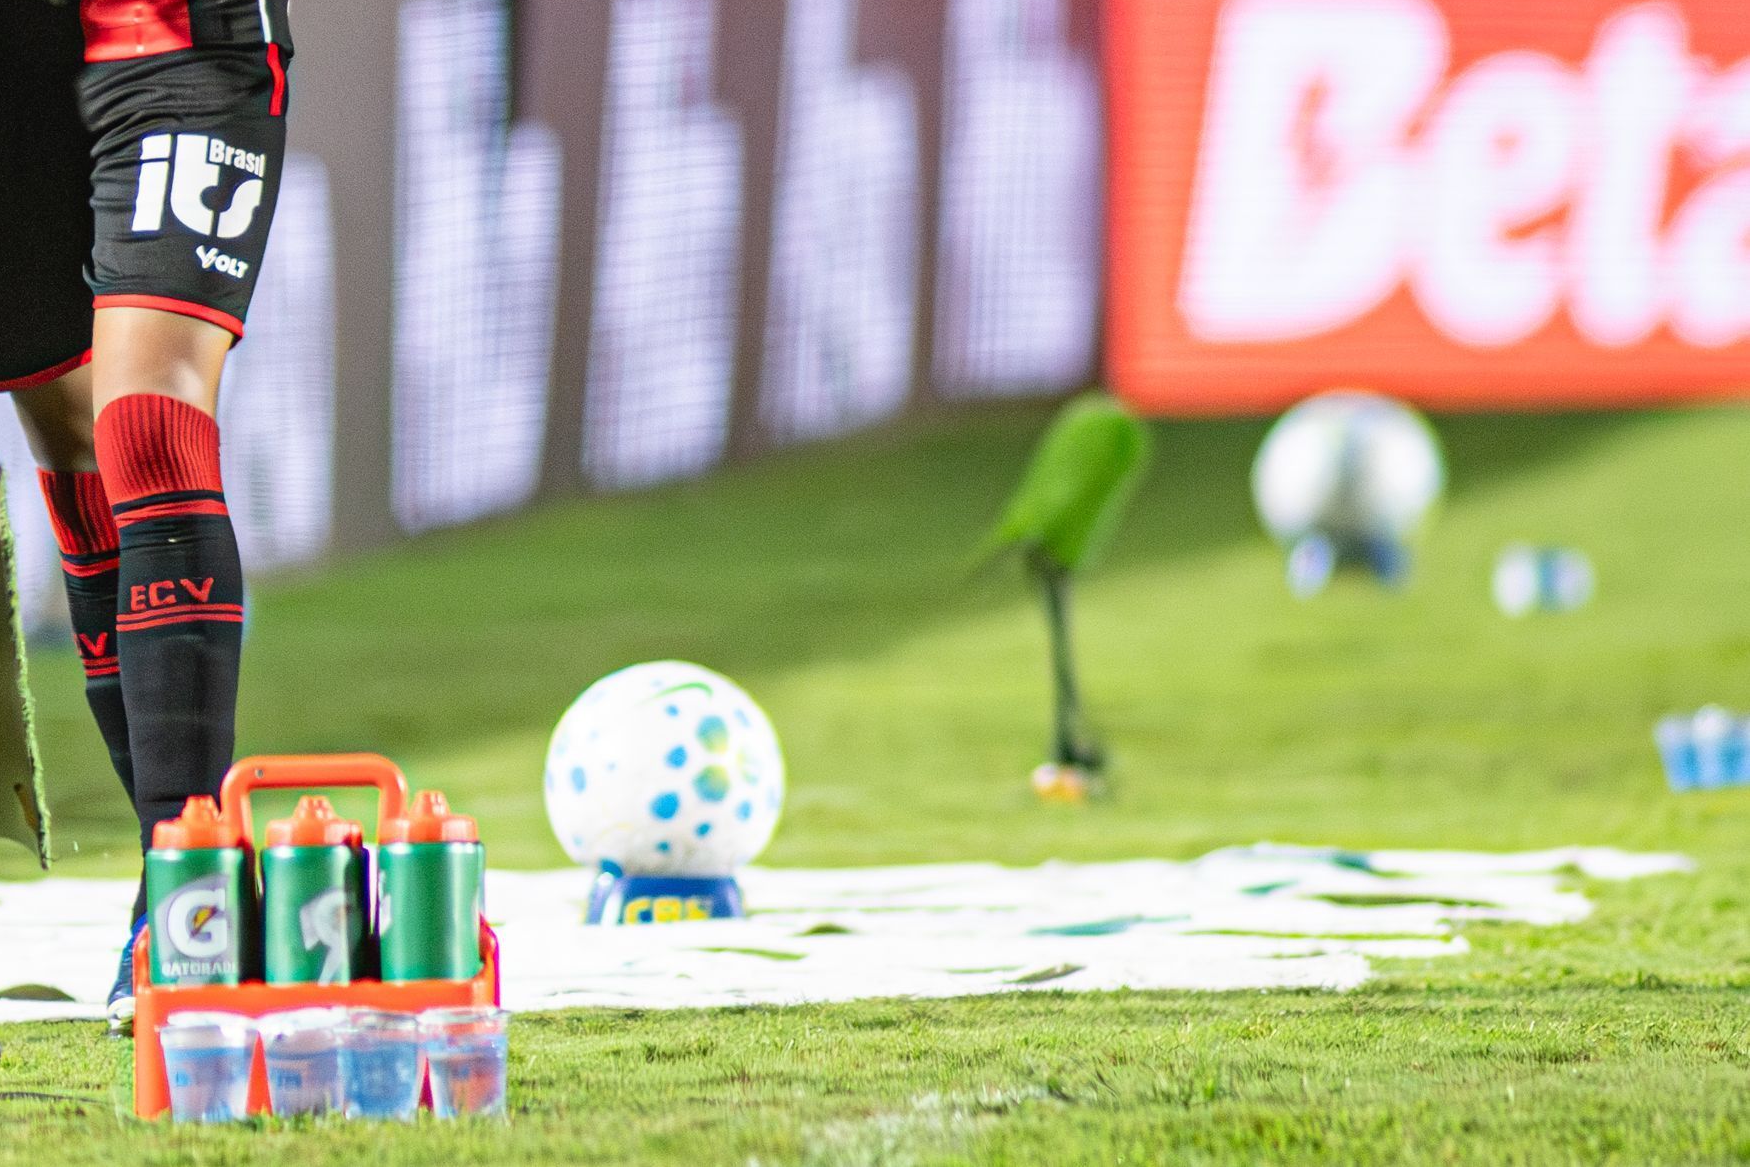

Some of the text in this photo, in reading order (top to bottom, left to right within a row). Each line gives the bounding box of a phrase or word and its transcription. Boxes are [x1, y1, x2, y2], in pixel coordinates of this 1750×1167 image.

[209, 138, 266, 178] Brasil
[196, 245, 248, 279] VOLT
[130, 577, 214, 611] ECV
